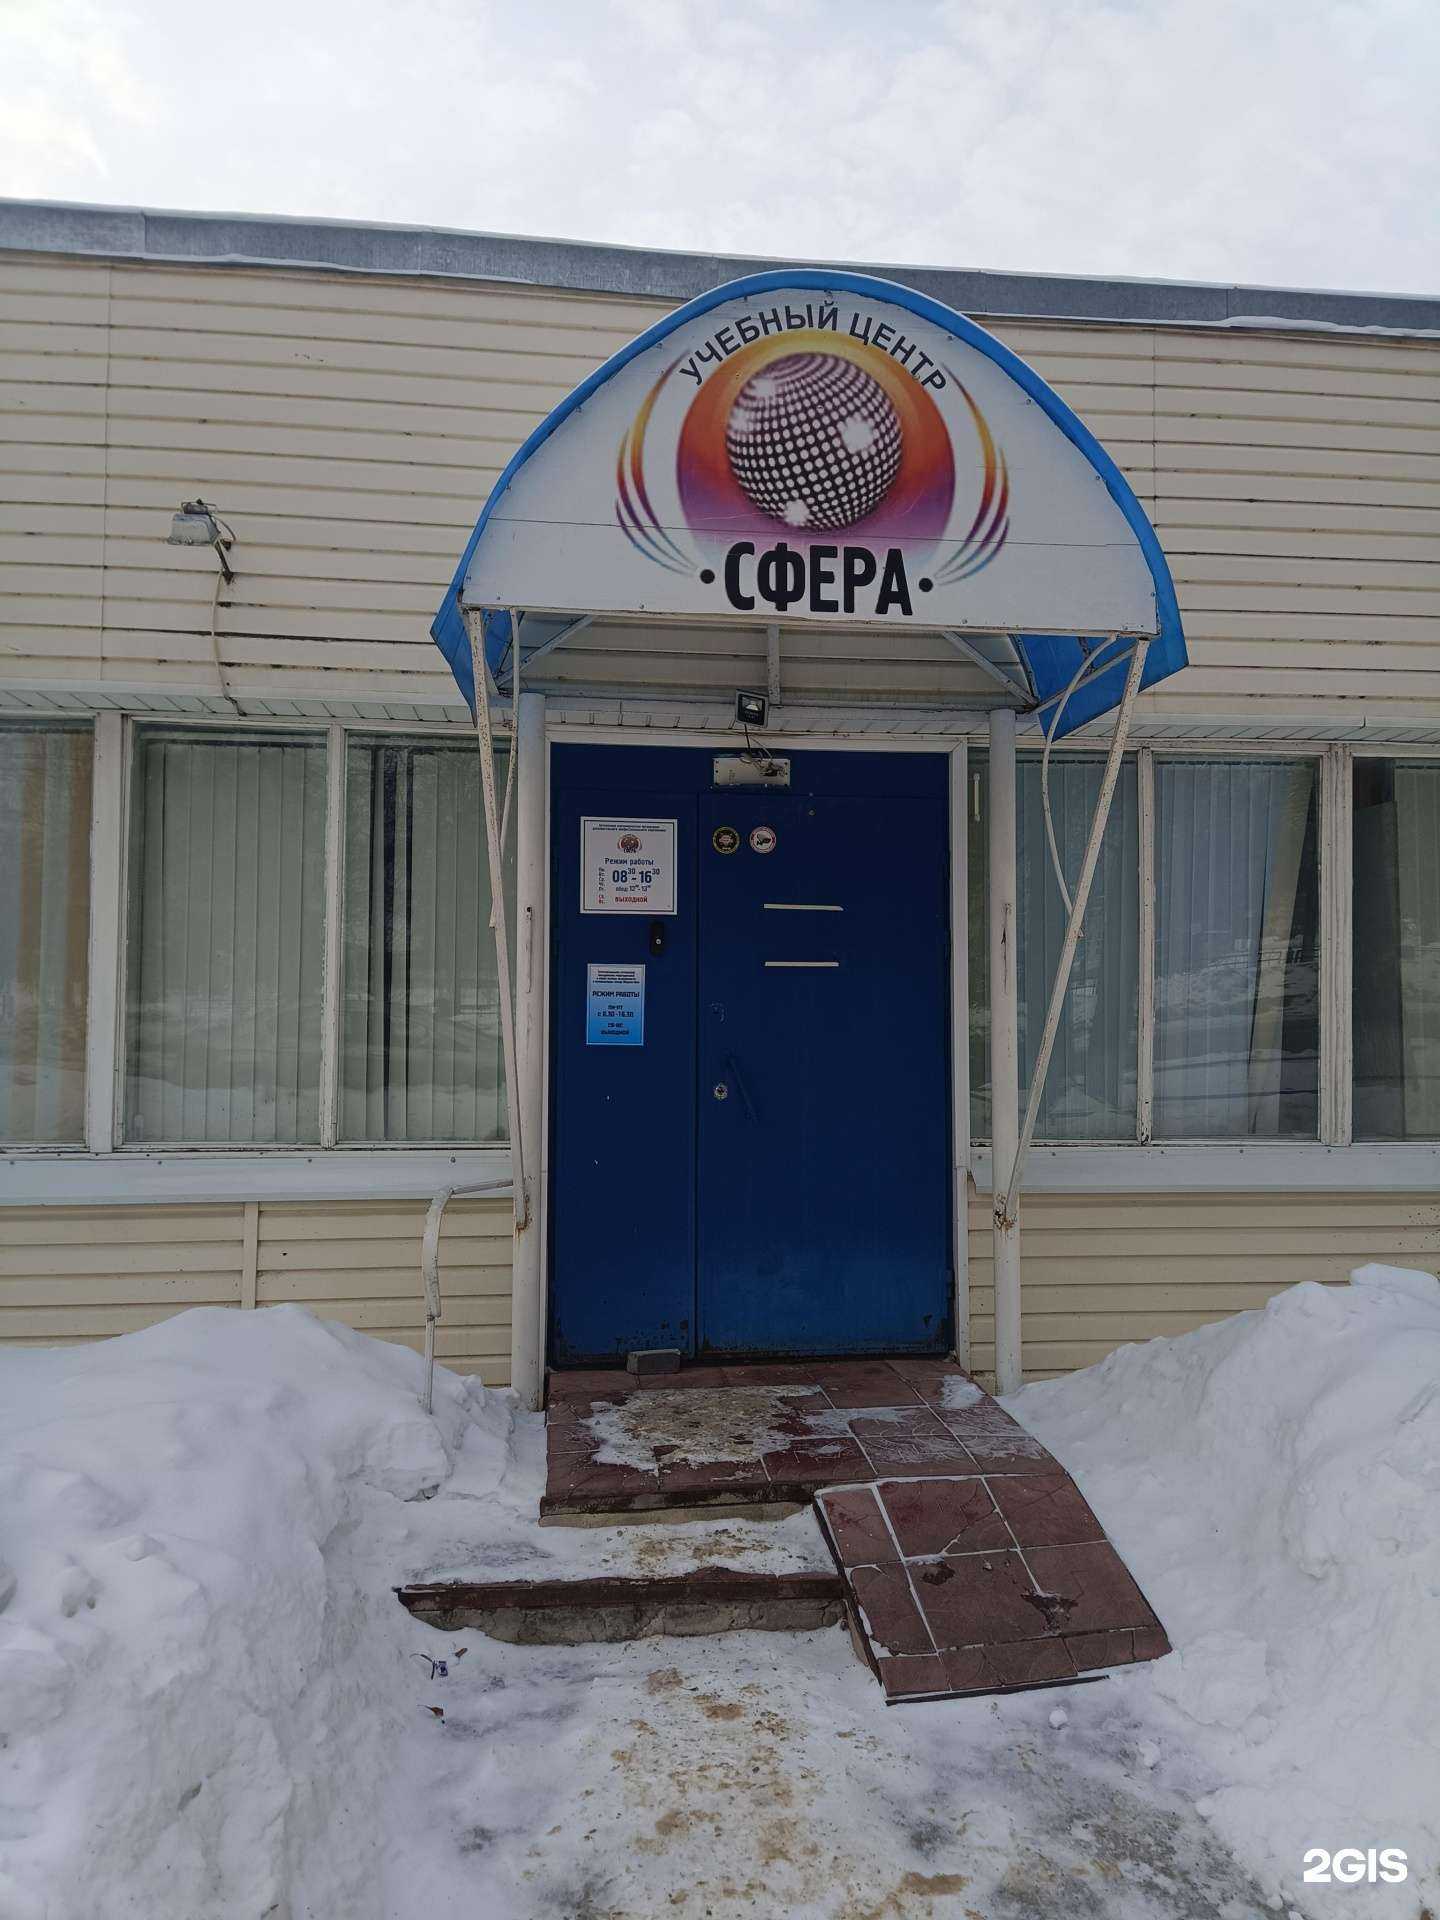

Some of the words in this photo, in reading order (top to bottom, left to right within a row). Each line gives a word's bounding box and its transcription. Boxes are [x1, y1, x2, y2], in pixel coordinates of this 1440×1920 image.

[679, 300, 839, 386] УЧЕБНЫЙ
[849, 312, 947, 391] ЦЕНТР
[724, 541, 913, 616] СФЕРА
[604, 857, 628, 865] Режим
[629, 858, 654, 867] работы
